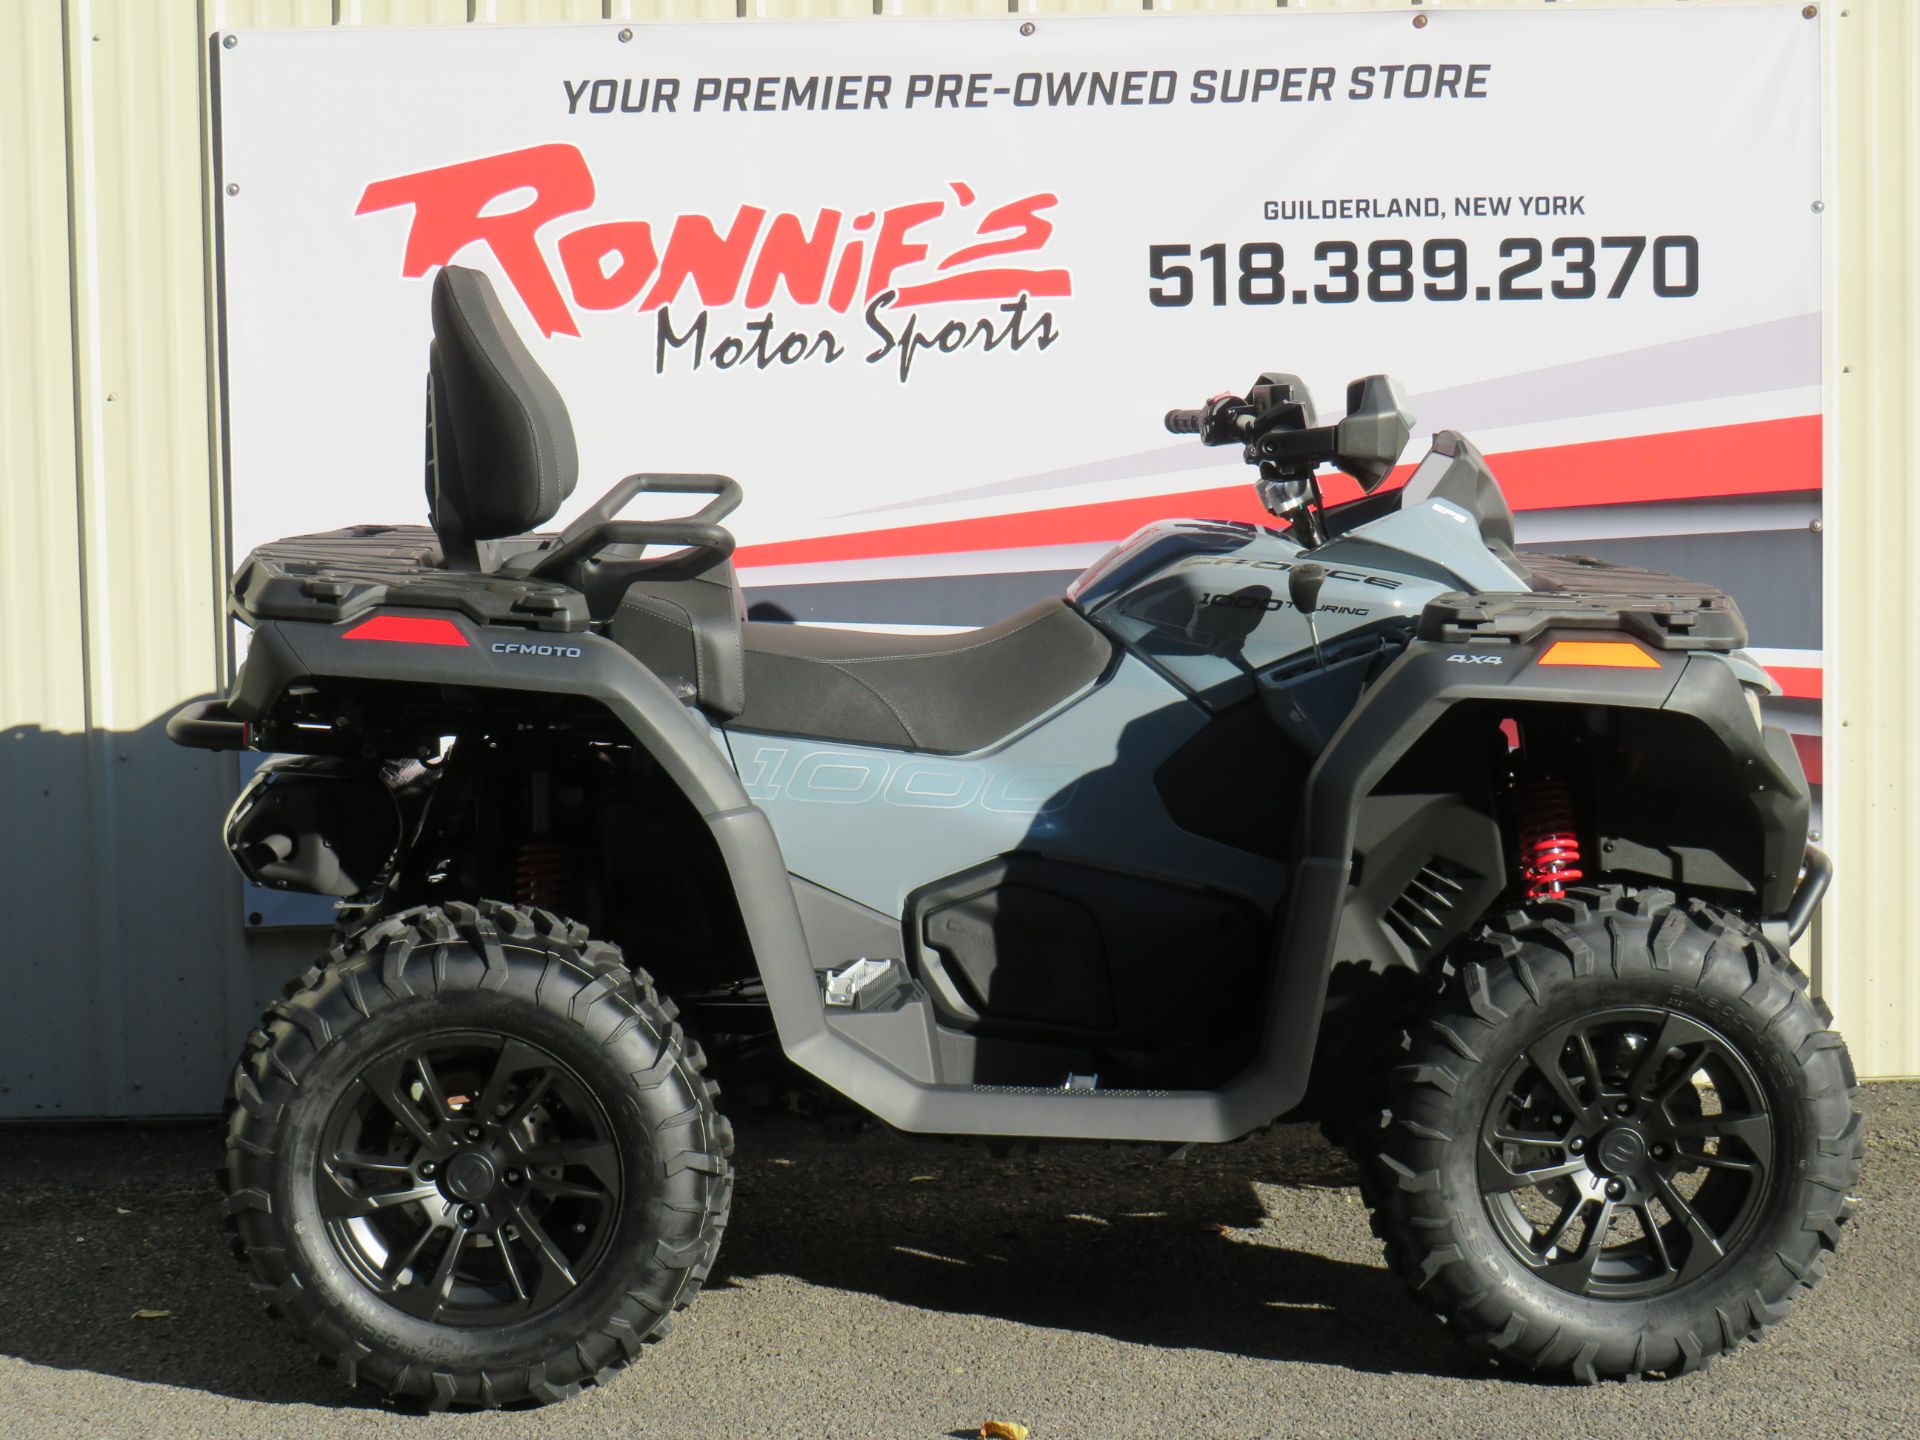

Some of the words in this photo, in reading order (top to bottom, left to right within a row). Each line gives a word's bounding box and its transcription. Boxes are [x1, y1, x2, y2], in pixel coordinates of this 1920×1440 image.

[564, 79, 680, 114] YOUR
[694, 76, 891, 112] PREMIER
[906, 71, 1177, 108] PRE-OWNED
[1191, 67, 1335, 103] SUPER
[1349, 64, 1491, 100] STORE
[1265, 198, 1445, 220] GUILDERLAND,
[1455, 197, 1511, 216] NEW
[1519, 196, 1584, 215] YORK
[1150, 235, 1698, 307] 518.389.2370
[657, 307, 843, 373] Motor
[866, 291, 1058, 382] Sports
[1179, 556, 1402, 590] CFOCE
[1200, 592, 1284, 611] 1000
[1286, 601, 1369, 616] TURING
[491, 643, 581, 658] CFMOTO
[1446, 654, 1503, 665] 4X4
[745, 748, 1081, 813] 1000
